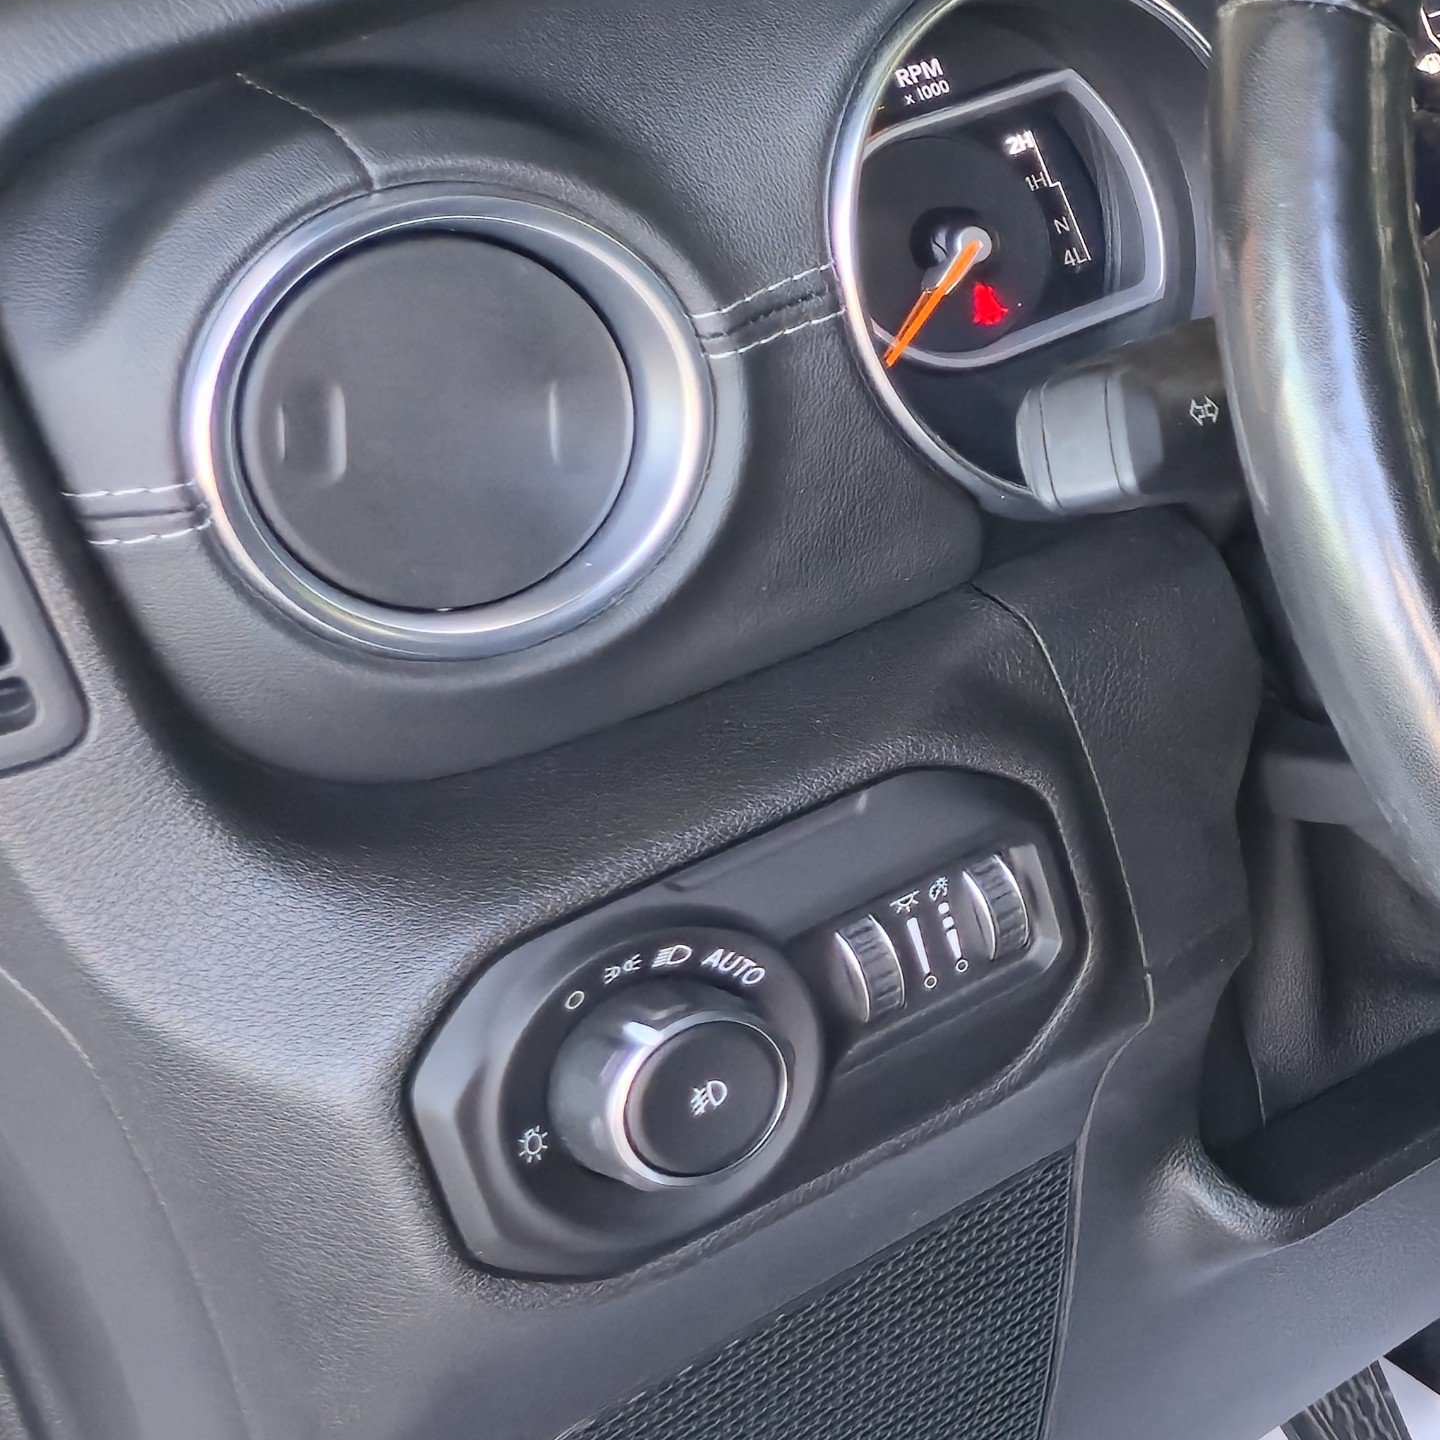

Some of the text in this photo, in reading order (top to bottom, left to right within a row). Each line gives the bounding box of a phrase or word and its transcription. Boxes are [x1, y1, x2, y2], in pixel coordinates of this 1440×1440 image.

[895, 57, 945, 89] RPM
[917, 79, 950, 101] 1000
[1053, 215, 1071, 235] N
[1063, 246, 1088, 267] 4L
[701, 948, 766, 986] AUTO
